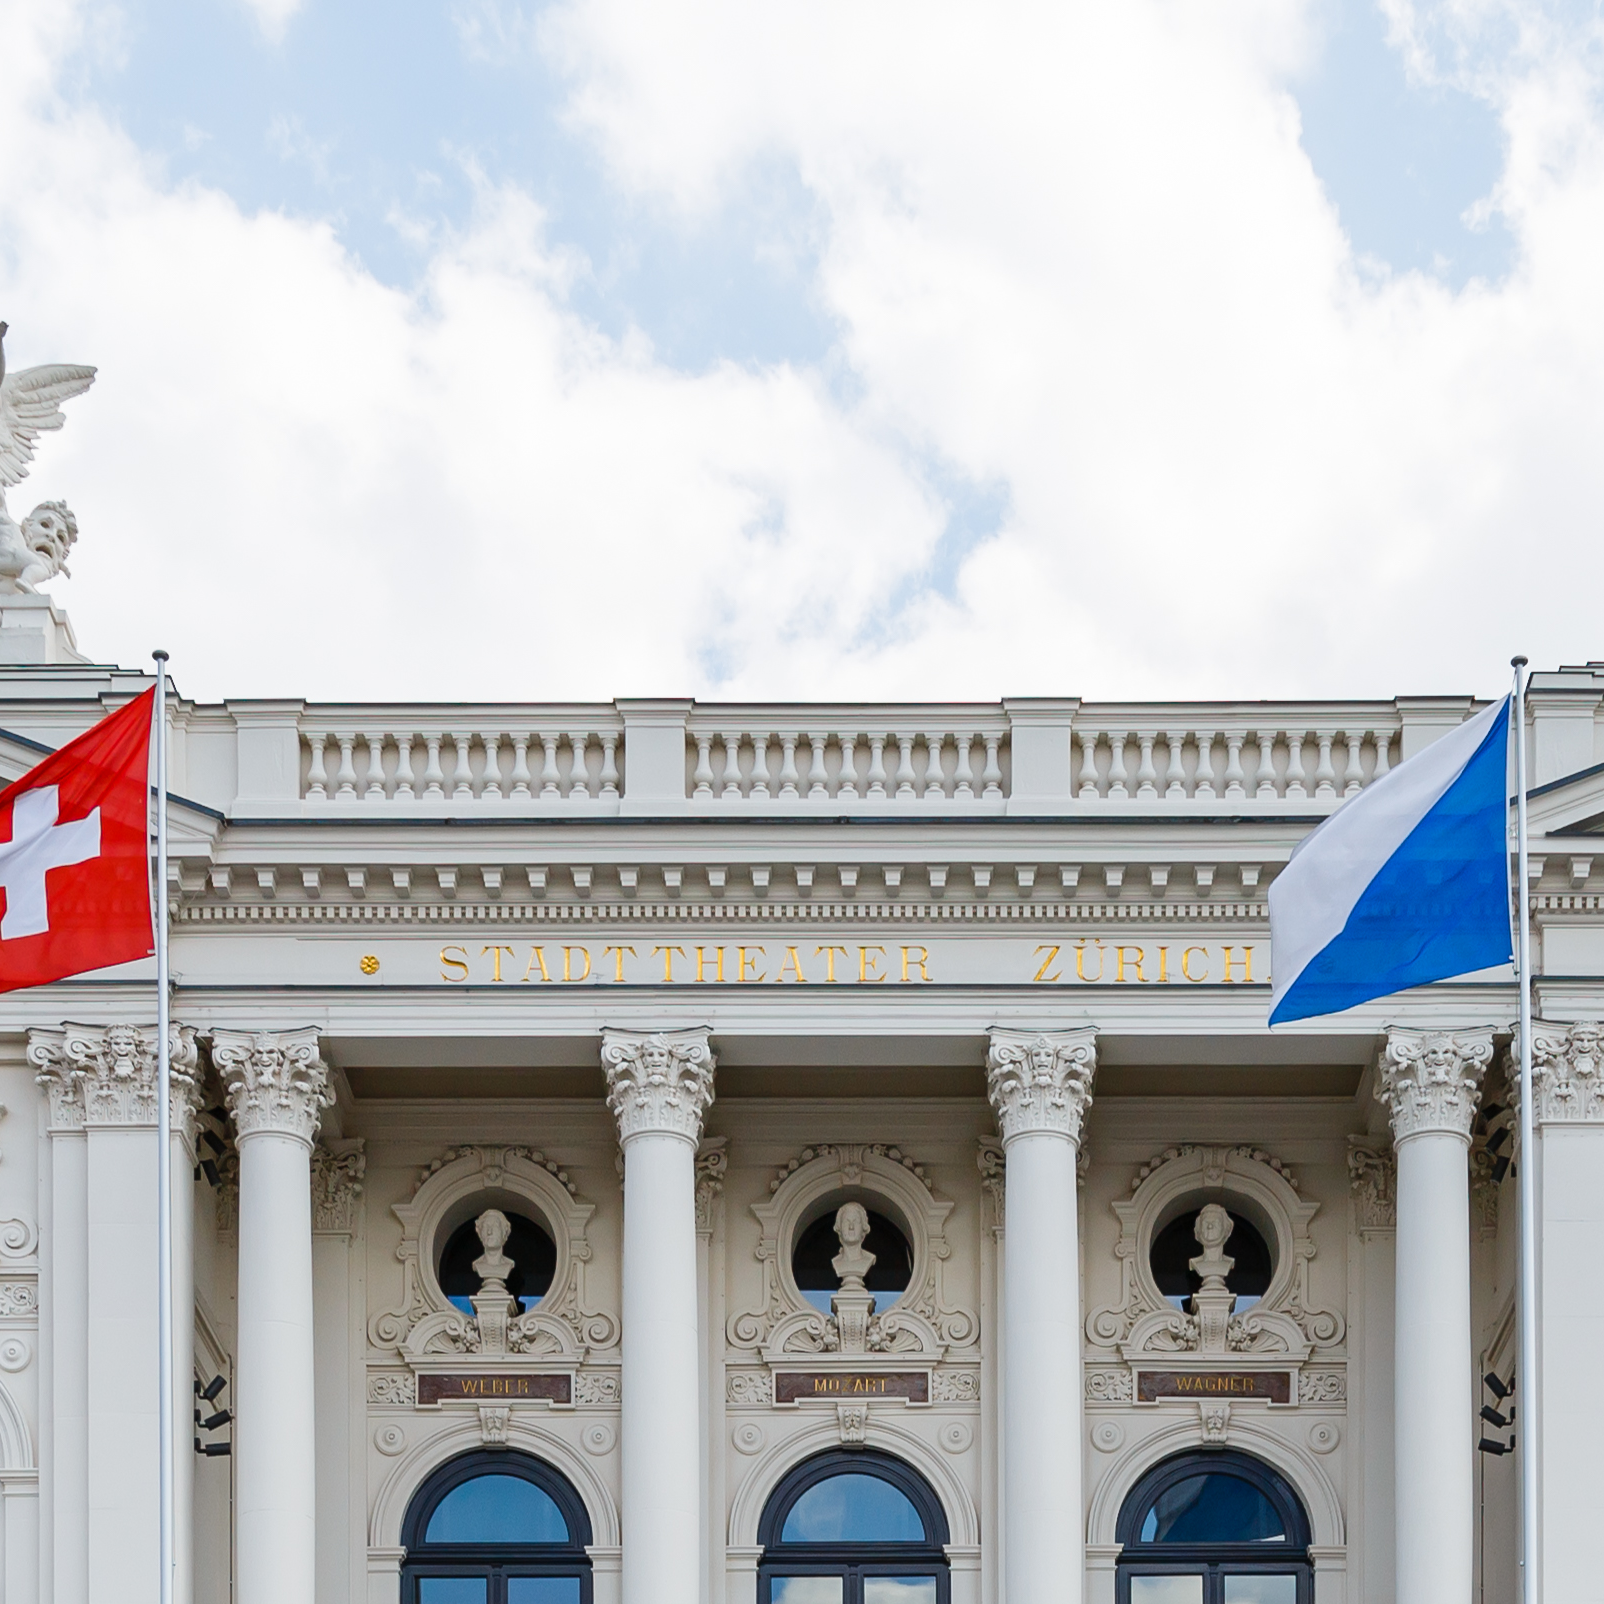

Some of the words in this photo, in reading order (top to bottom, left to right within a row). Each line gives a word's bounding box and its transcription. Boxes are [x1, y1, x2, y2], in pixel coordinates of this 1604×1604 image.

[461, 1379, 529, 1394] WEBER
[814, 1378, 888, 1393] MOZART
[1176, 1377, 1255, 1391] WAGNER
